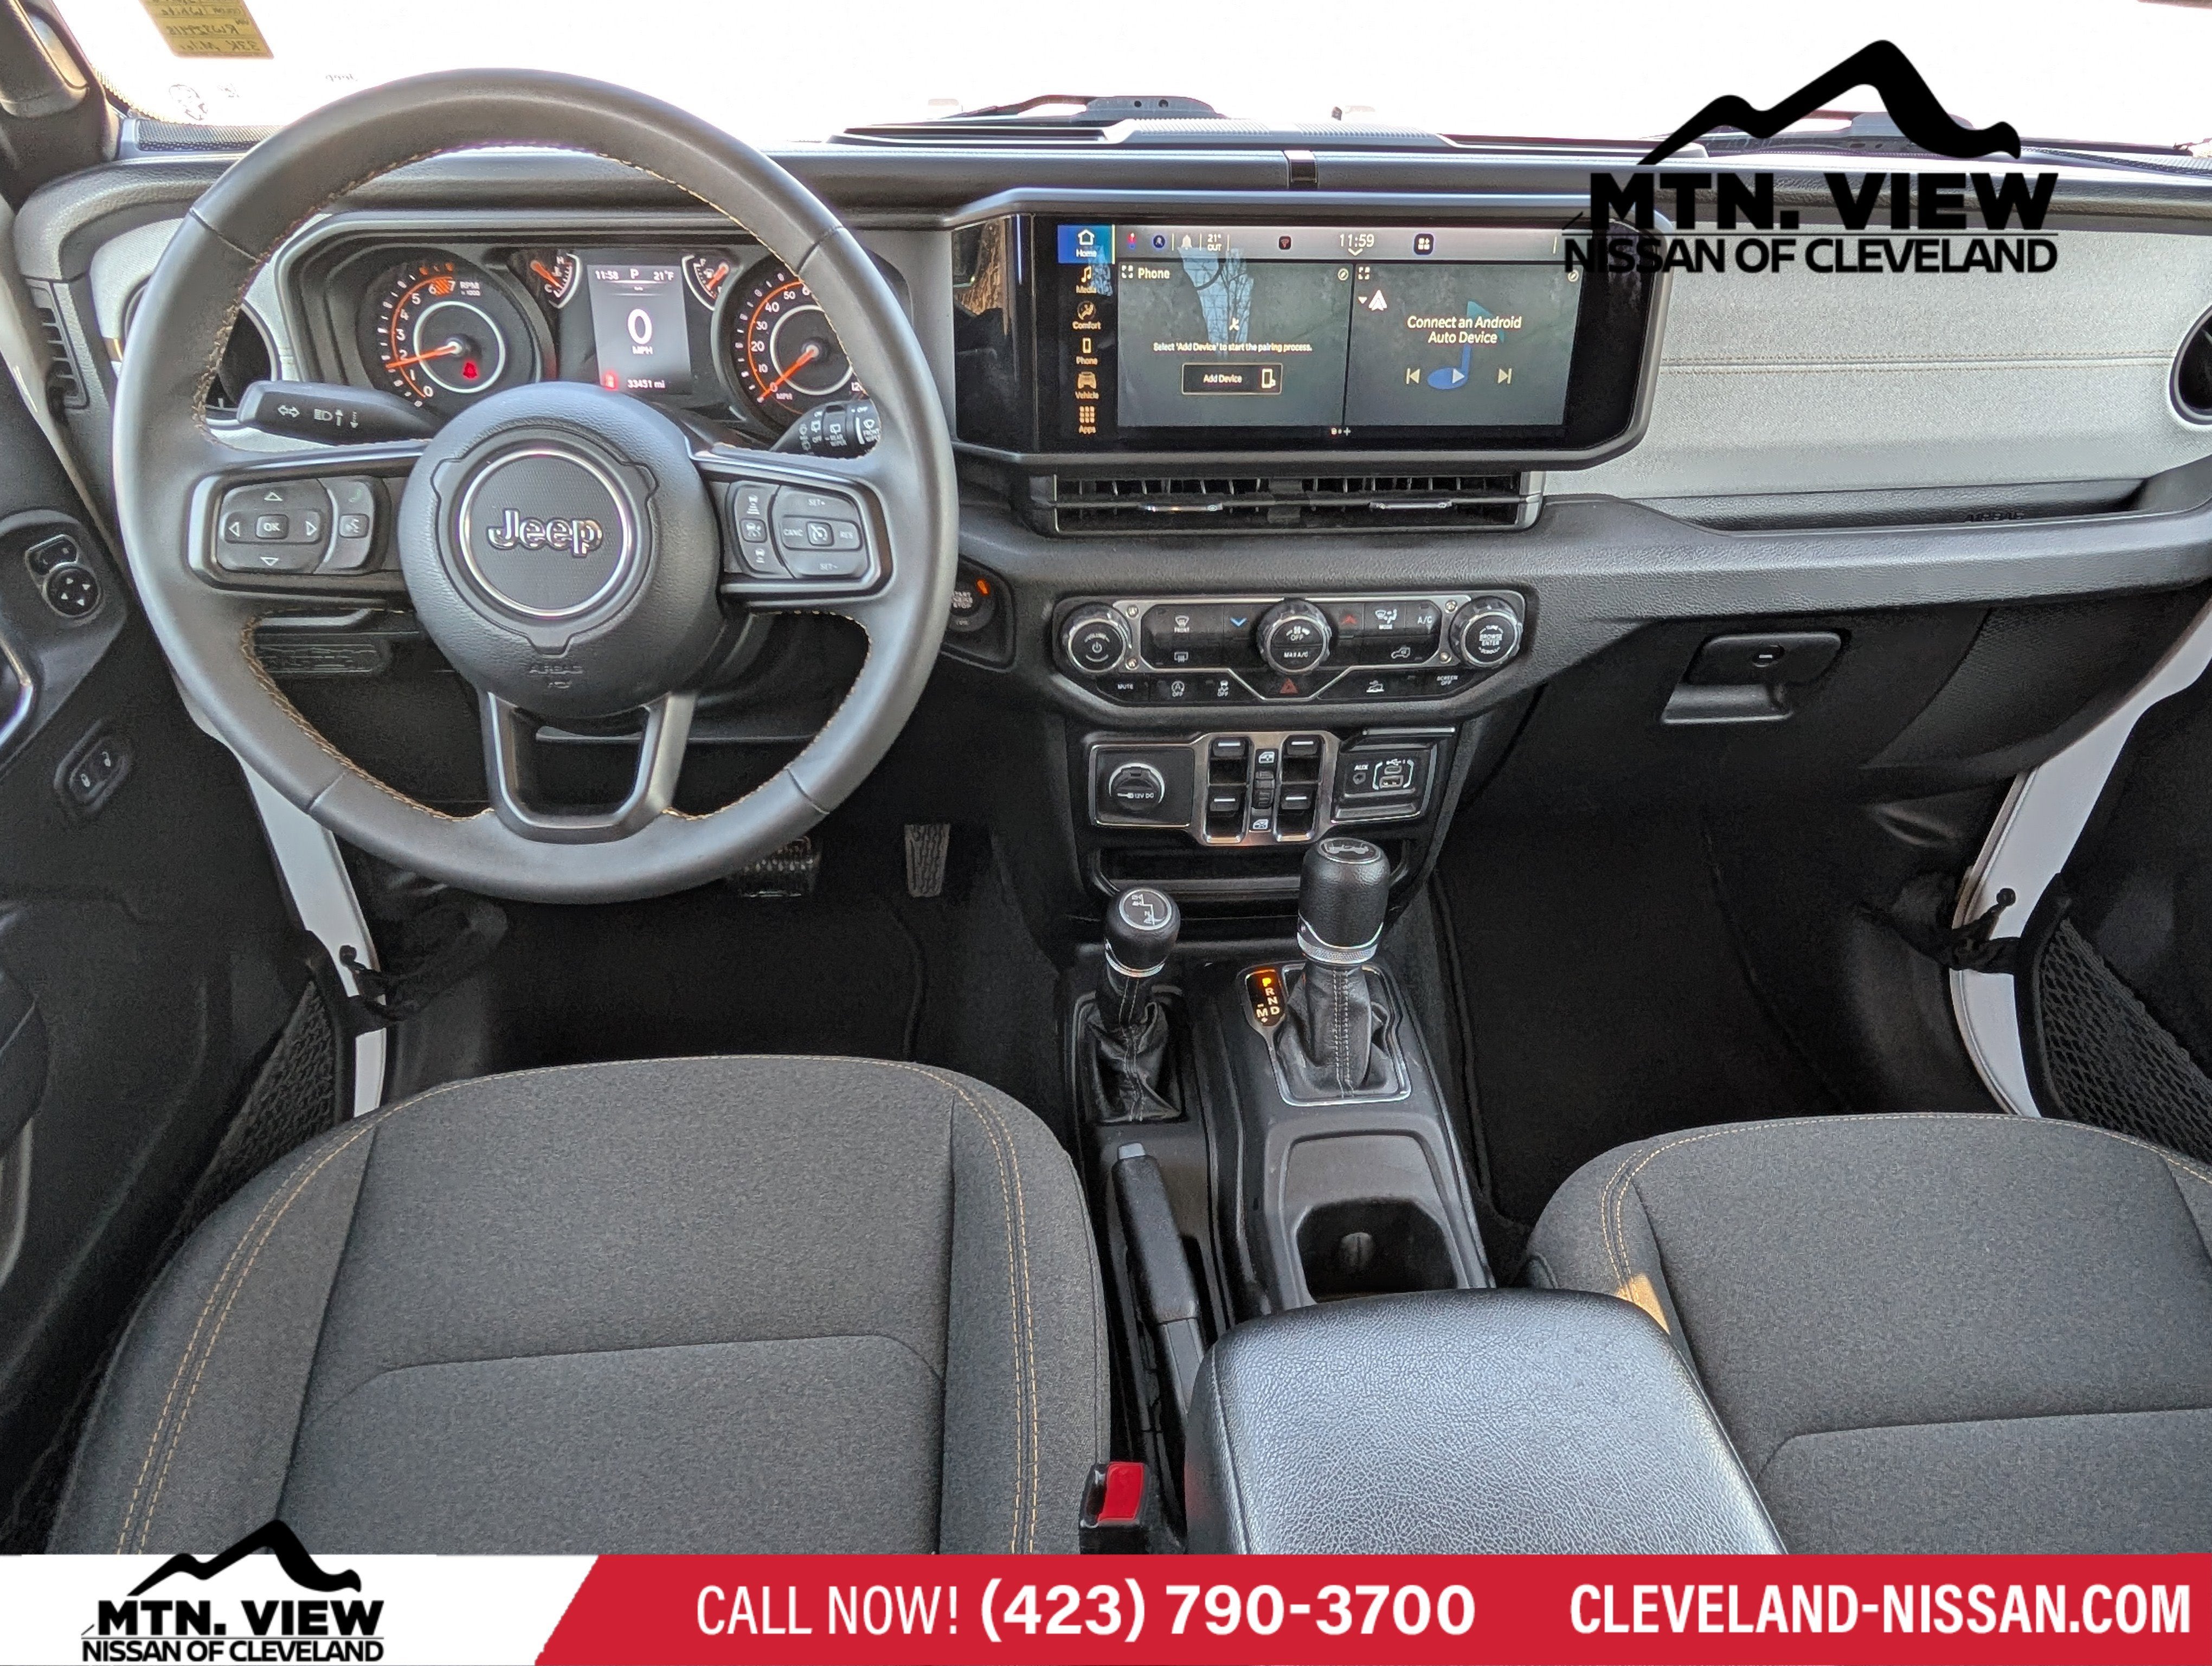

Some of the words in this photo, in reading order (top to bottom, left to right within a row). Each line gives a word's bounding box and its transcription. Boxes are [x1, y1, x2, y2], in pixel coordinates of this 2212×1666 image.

[1340, 234, 1374, 248] 11:59
[1076, 249, 1097, 258] Home
[630, 268, 639, 279] P
[1138, 267, 1170, 279] Phone
[428, 283, 436, 294] 6
[448, 280, 456, 291] 7
[460, 281, 480, 290] RPM
[1076, 285, 1097, 293] Media
[411, 293, 421, 305] 5
[783, 290, 796, 300] 50
[764, 301, 780, 313] 40
[400, 309, 409, 321] 4
[627, 308, 653, 345] 0
[755, 321, 768, 331] 30
[1072, 321, 1101, 330] Comfort
[1407, 316, 1457, 329] Connect
[1458, 318, 1473, 328] an
[1474, 316, 1522, 329] Android
[396, 328, 406, 341] 3
[1427, 331, 1457, 343] Auto
[1458, 331, 1497, 343] Device
[632, 346, 653, 355] MPH
[750, 341, 766, 353] 20
[1153, 342, 1175, 352] Select
[1219, 343, 1227, 351] to
[1228, 343, 1244, 351] start
[1246, 343, 1257, 351] the
[1258, 342, 1282, 353] pairing
[399, 349, 408, 361] 2
[1076, 356, 1098, 365] Phone
[757, 363, 769, 374] 10
[409, 369, 416, 381] 1
[1203, 374, 1218, 383] Add
[1219, 374, 1242, 383] Device
[627, 380, 653, 389] 33451
[654, 380, 666, 389] mi
[422, 385, 434, 398] 0
[776, 392, 793, 401] MPH
[1075, 391, 1099, 400] Vehicle
[1078, 426, 1096, 434] Apps
[263, 522, 281, 533] OK
[487, 508, 603, 557] Jeep
[1417, 616, 1433, 624] A/C
[1262, 977, 1272, 988] P
[1265, 987, 1275, 996] R
[1267, 996, 1278, 1005] N
[1256, 1008, 1269, 1018] M
[1270, 1006, 1280, 1015] D
